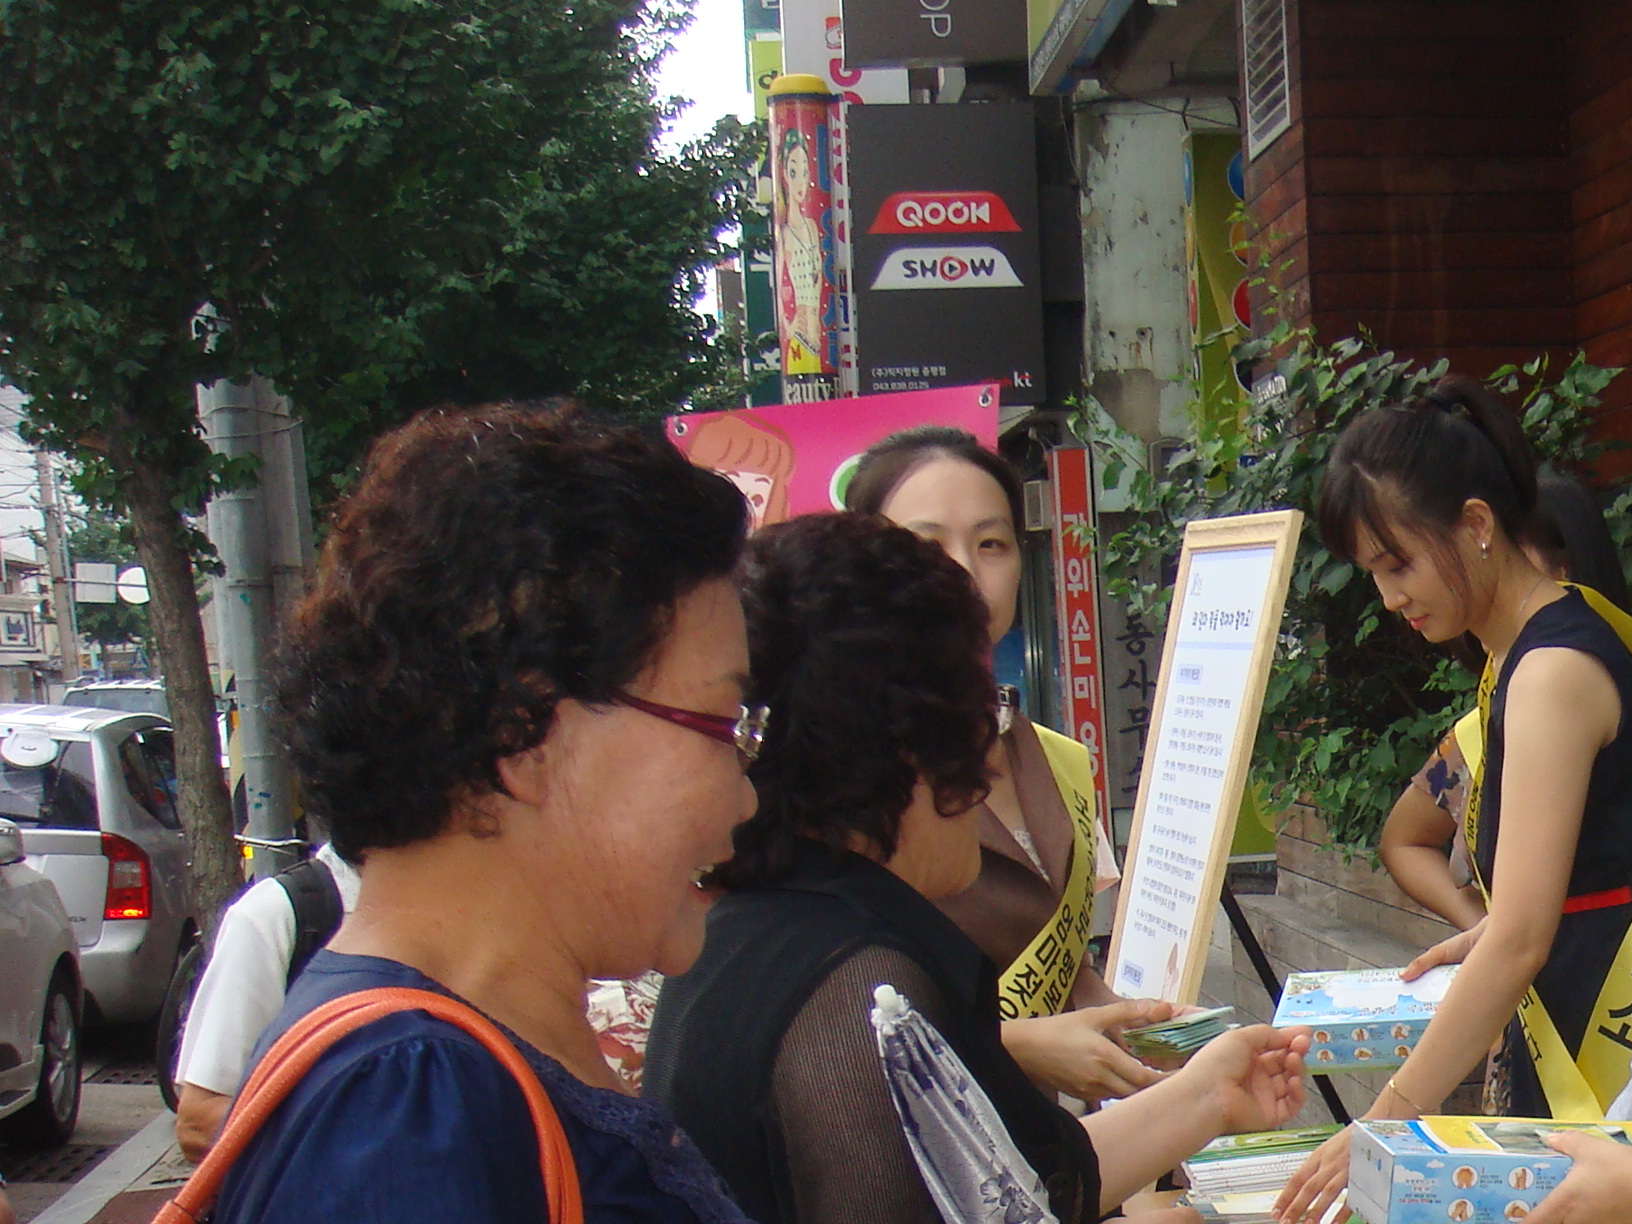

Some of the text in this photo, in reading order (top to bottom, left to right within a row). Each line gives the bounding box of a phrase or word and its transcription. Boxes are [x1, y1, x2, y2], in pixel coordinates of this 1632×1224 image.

[896, 200, 991, 227] QOOK
[902, 256, 995, 282] SHOW
[1013, 371, 1033, 388] kt
